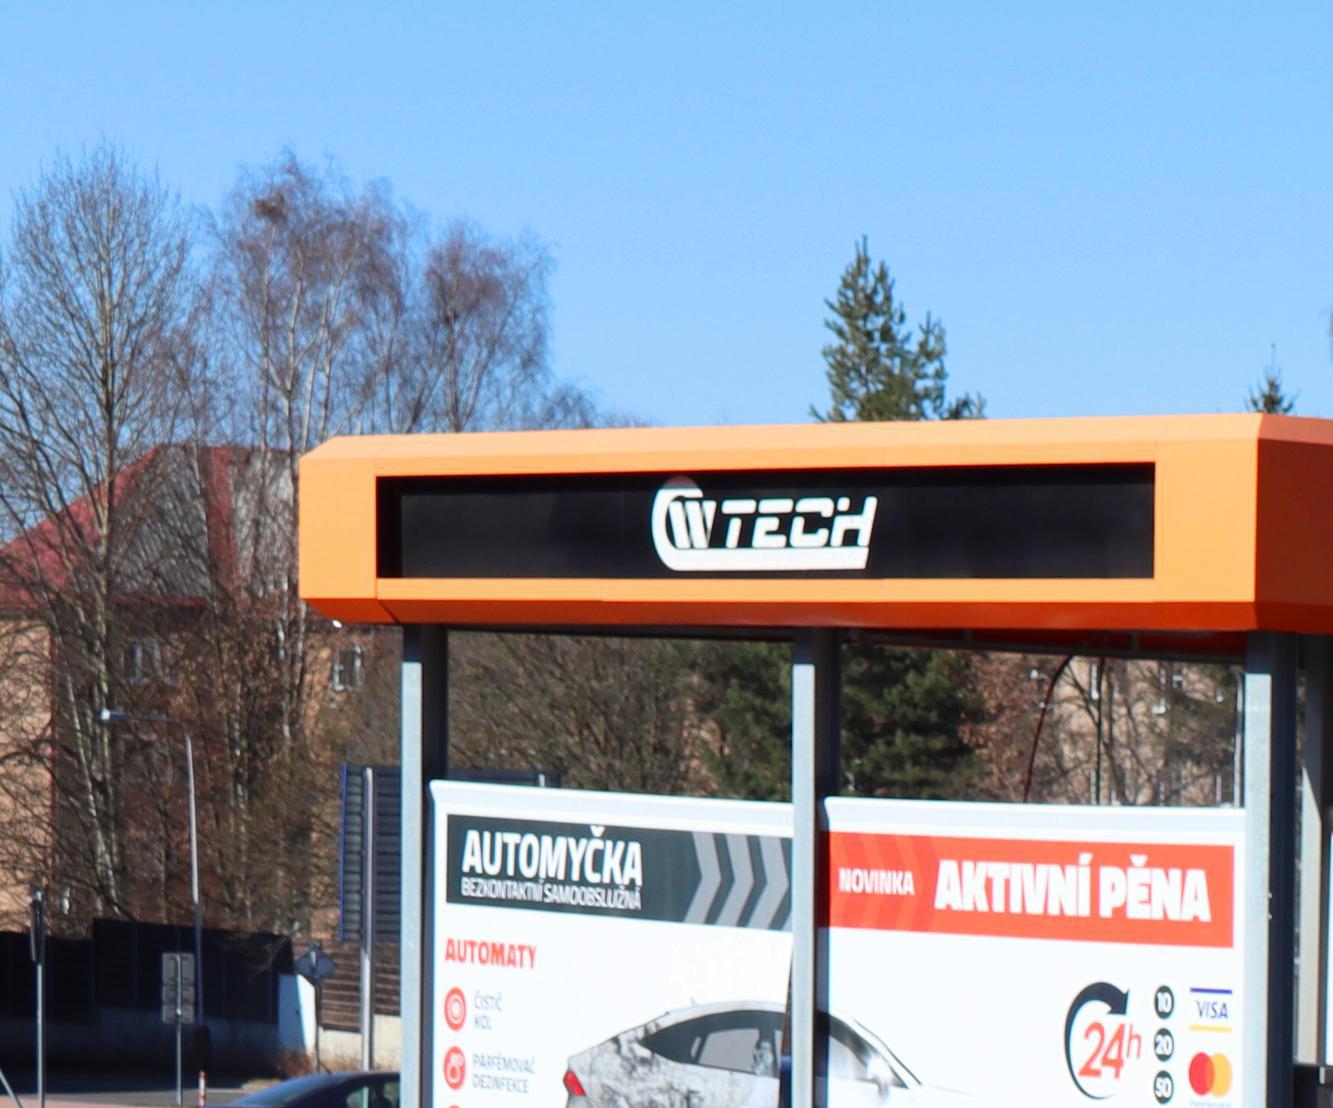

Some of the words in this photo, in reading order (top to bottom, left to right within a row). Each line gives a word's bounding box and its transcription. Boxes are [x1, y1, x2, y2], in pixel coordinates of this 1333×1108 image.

[461, 825, 643, 886] AUTOMYČKA
[838, 867, 914, 896] NOVINKA
[934, 852, 1093, 916] AKTIVNÍ
[1099, 854, 1212, 922] PĚNA
[445, 938, 537, 969] AUTOMATY
[1156, 992, 1172, 1014] 10
[1196, 1000, 1228, 1019] VISA
[1078, 1020, 1142, 1080] 24h
[1155, 1034, 1173, 1056] 20
[1155, 1076, 1172, 1098] 50
